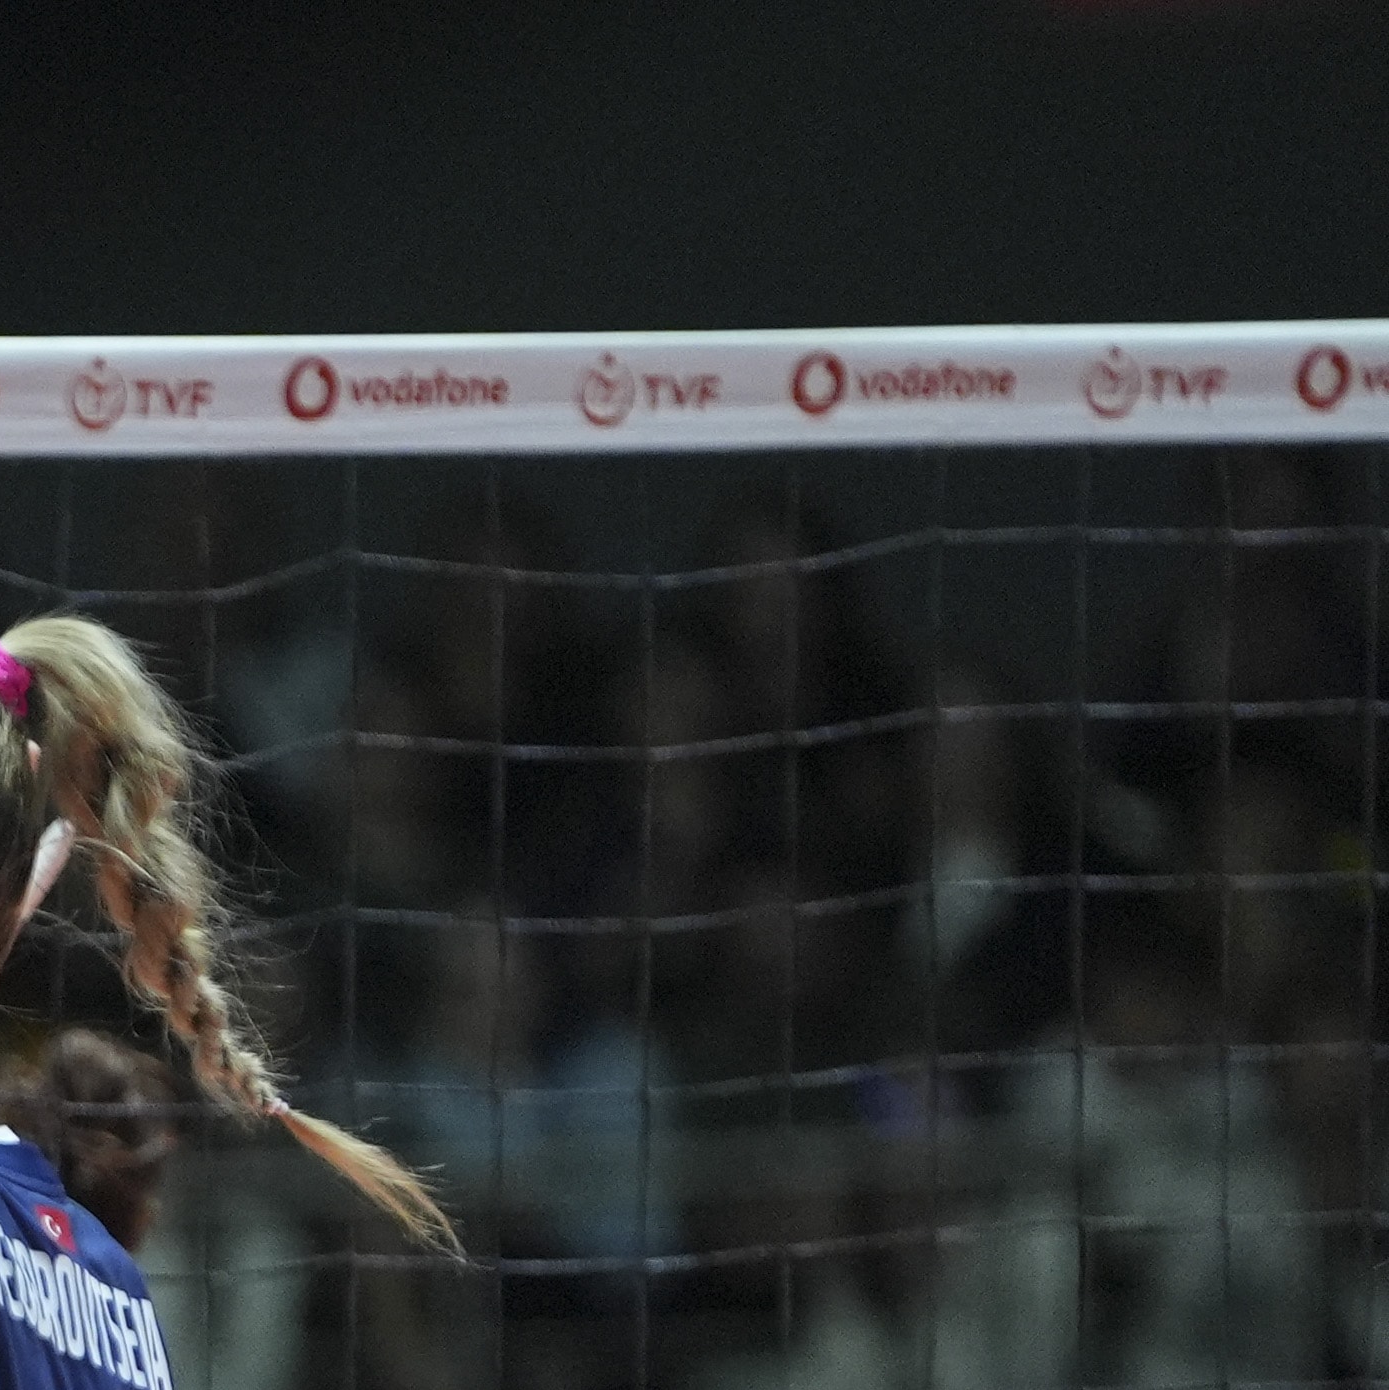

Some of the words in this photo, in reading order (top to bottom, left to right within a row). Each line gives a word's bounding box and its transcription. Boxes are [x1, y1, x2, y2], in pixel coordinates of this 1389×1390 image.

[134, 378, 212, 417] TVF
[350, 370, 509, 409] vodafone
[645, 373, 721, 412] TVF
[858, 361, 1015, 401] vodafone
